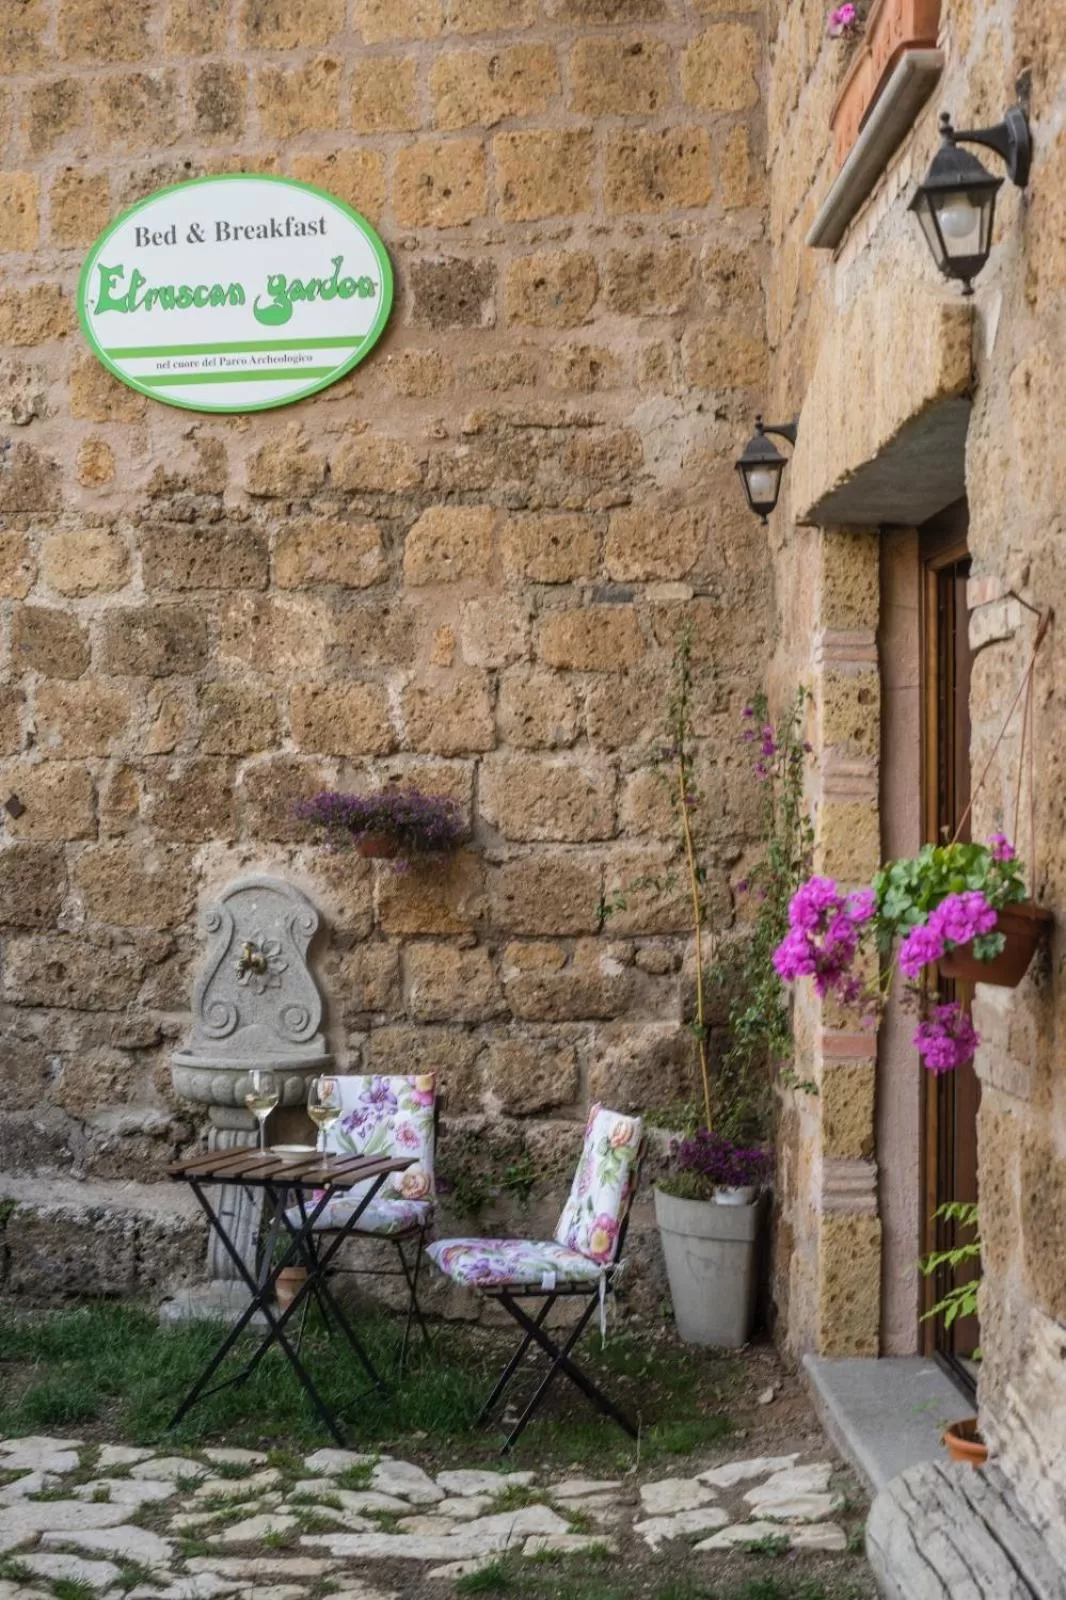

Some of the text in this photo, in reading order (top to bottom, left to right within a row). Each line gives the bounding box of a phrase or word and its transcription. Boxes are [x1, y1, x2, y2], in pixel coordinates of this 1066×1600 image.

[135, 216, 327, 247] Bed & Breakfast
[156, 354, 313, 370] nel cuore del Parco Archeologico
